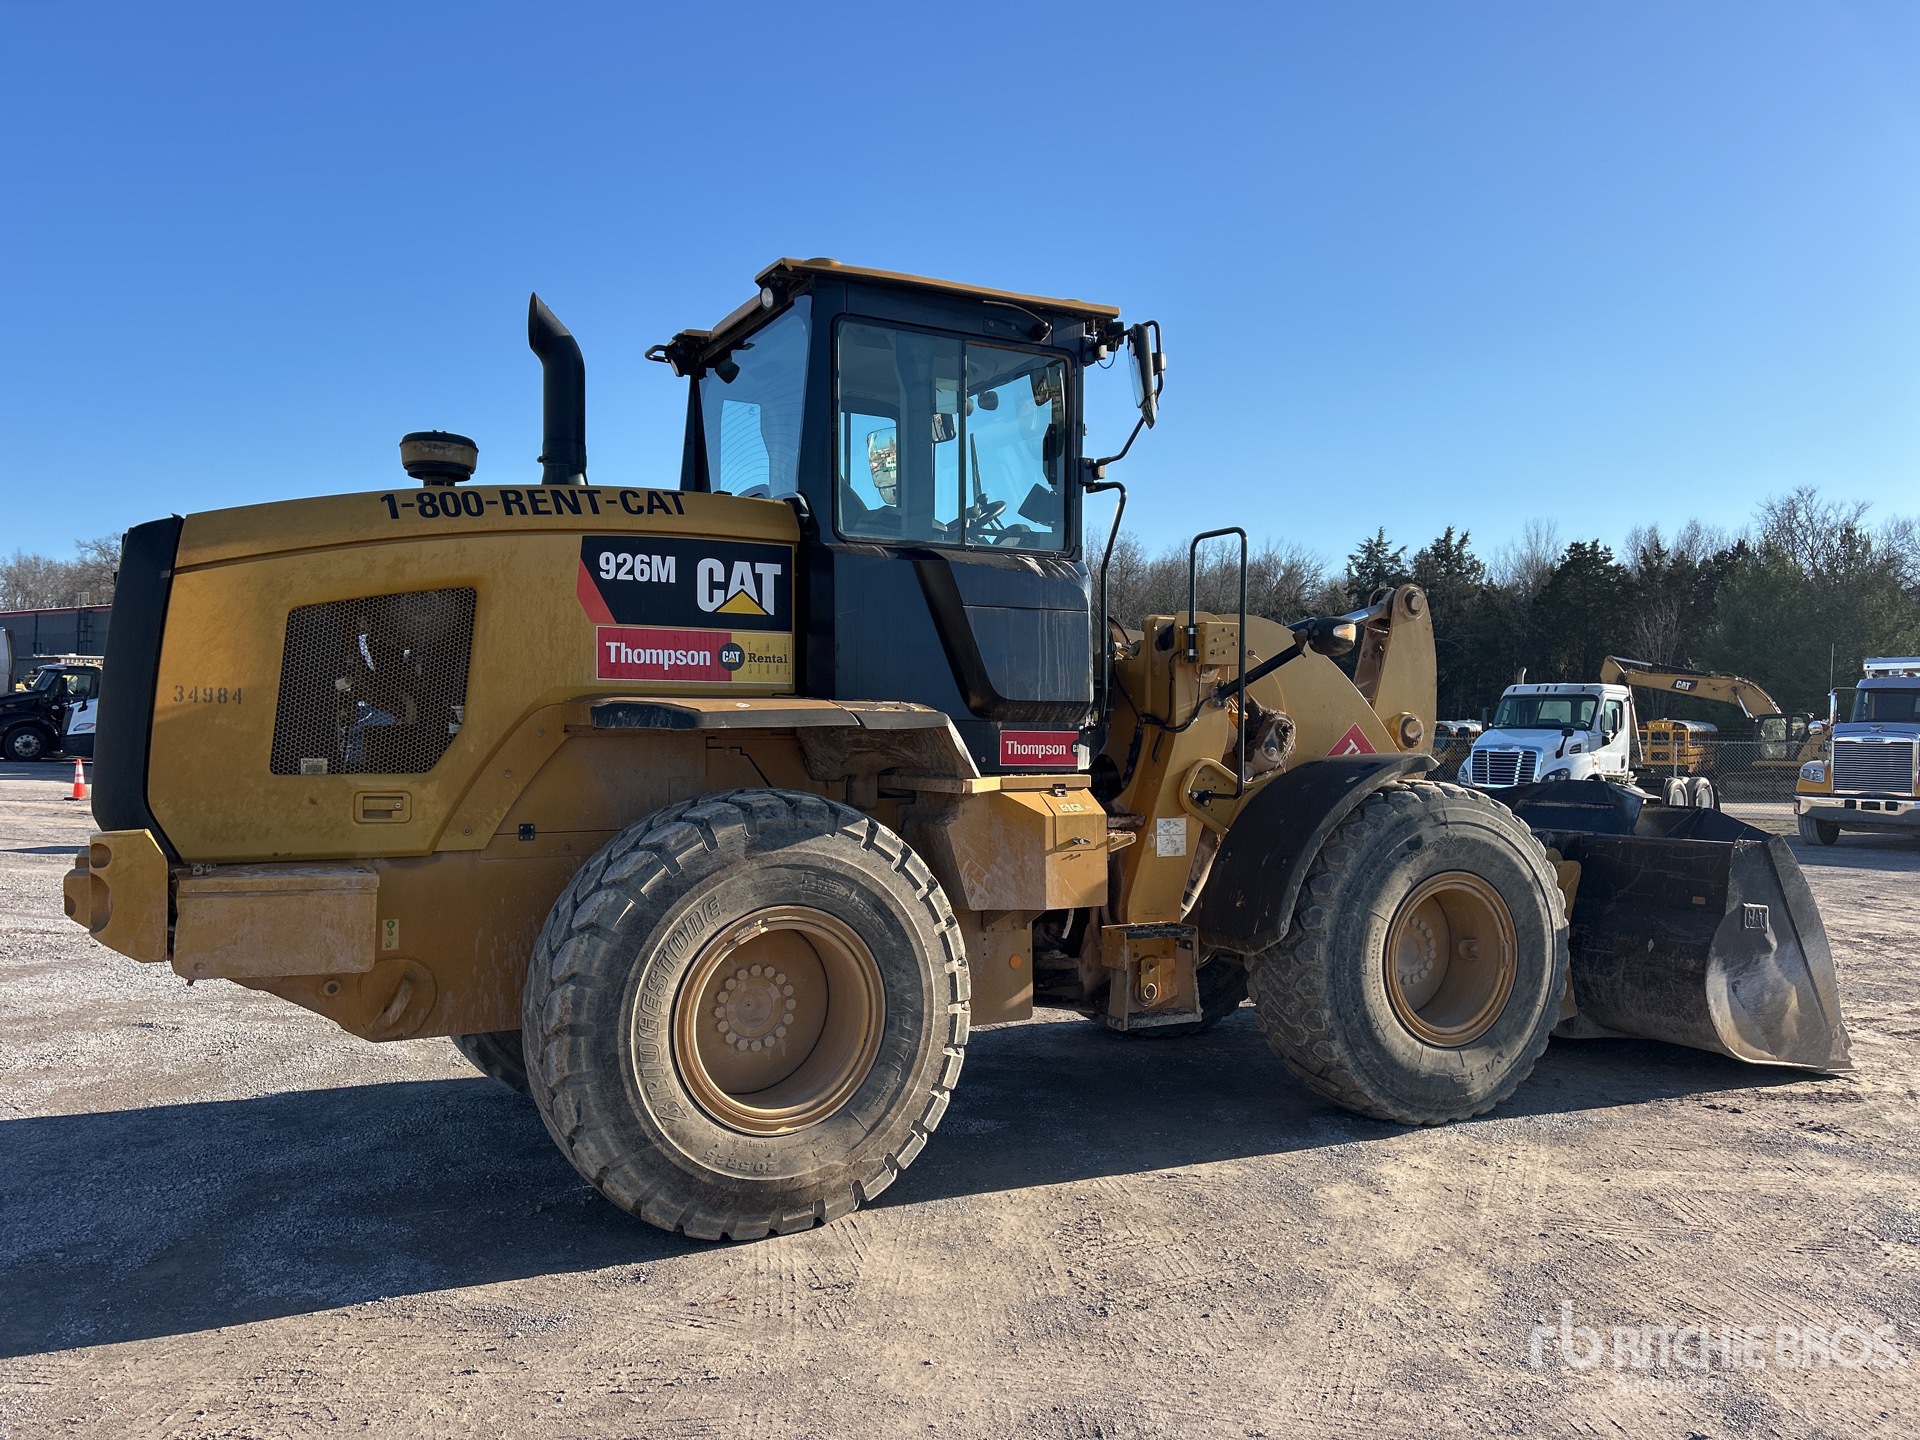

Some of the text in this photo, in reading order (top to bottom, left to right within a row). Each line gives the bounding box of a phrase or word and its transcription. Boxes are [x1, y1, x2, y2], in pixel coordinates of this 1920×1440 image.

[380, 488, 687, 520] 1-800-RENT-CAT
[599, 551, 782, 616] 926M CAT
[605, 641, 788, 671] Thompson CAT Rental
[172, 684, 243, 705] 34984
[1676, 680, 1692, 691] CAT
[1005, 740, 1067, 759] Thompson
[1744, 907, 1768, 929] CAT
[636, 895, 722, 1129] BRIDGESTONE
